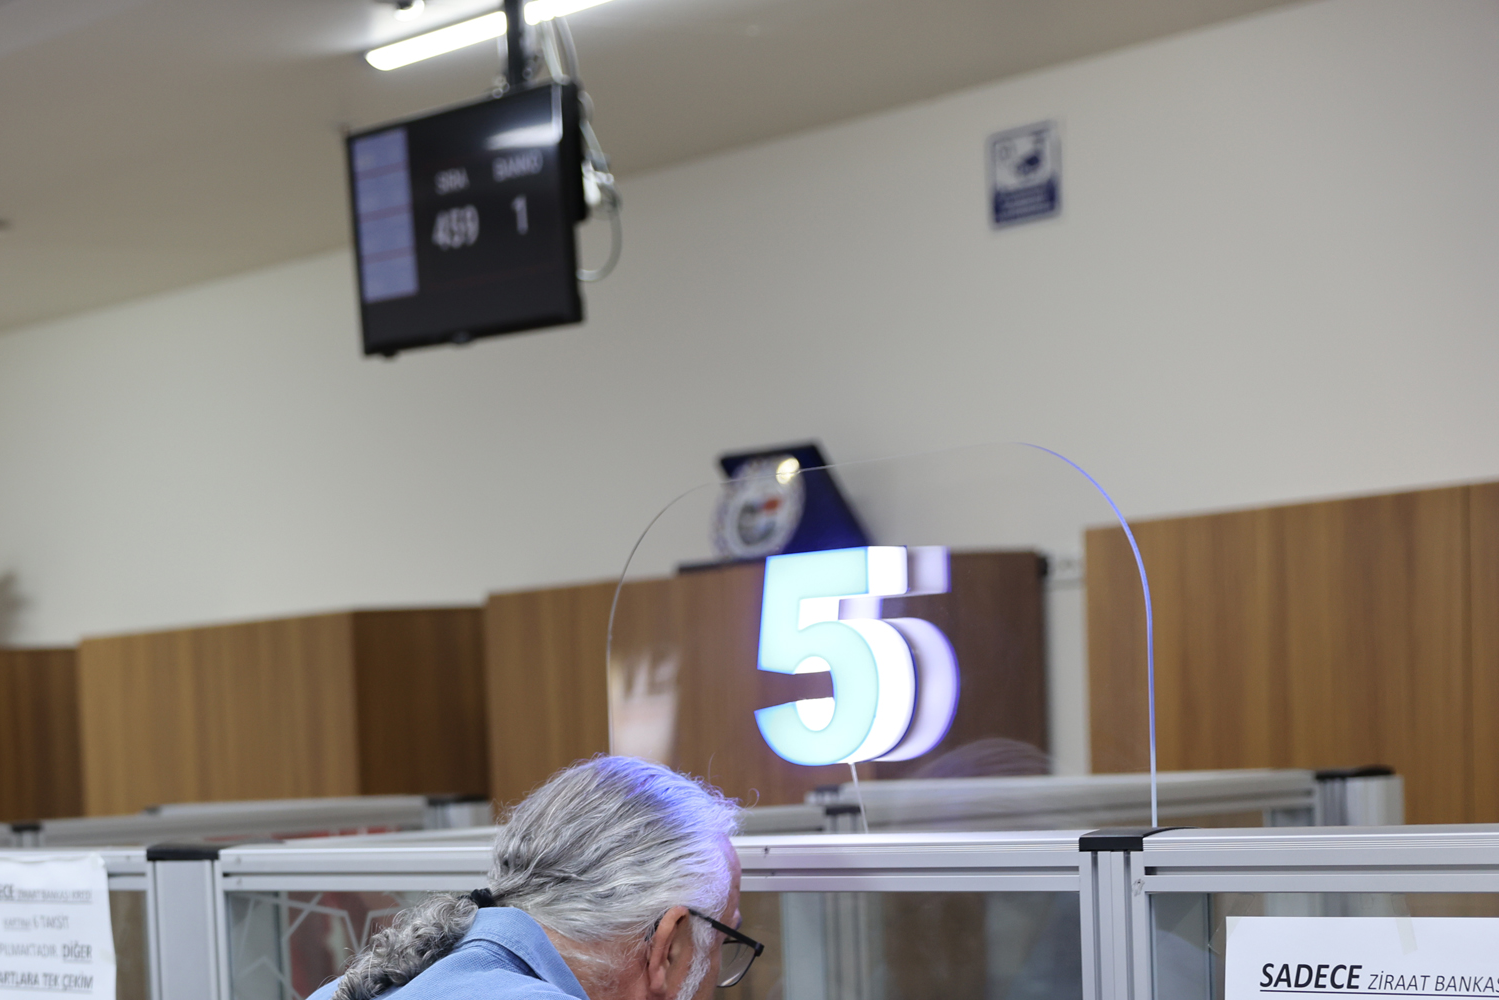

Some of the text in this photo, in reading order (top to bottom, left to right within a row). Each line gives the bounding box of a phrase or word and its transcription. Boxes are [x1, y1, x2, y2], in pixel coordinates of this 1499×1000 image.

[511, 193, 529, 236] 1
[754, 545, 920, 767] 5
[62, 940, 92, 959] DİĞER
[43, 973, 60, 987] TEK
[62, 971, 93, 990] ÇEKİM
[1259, 962, 1363, 991] SADECE
[1367, 970, 1430, 991] ZİRAAT
